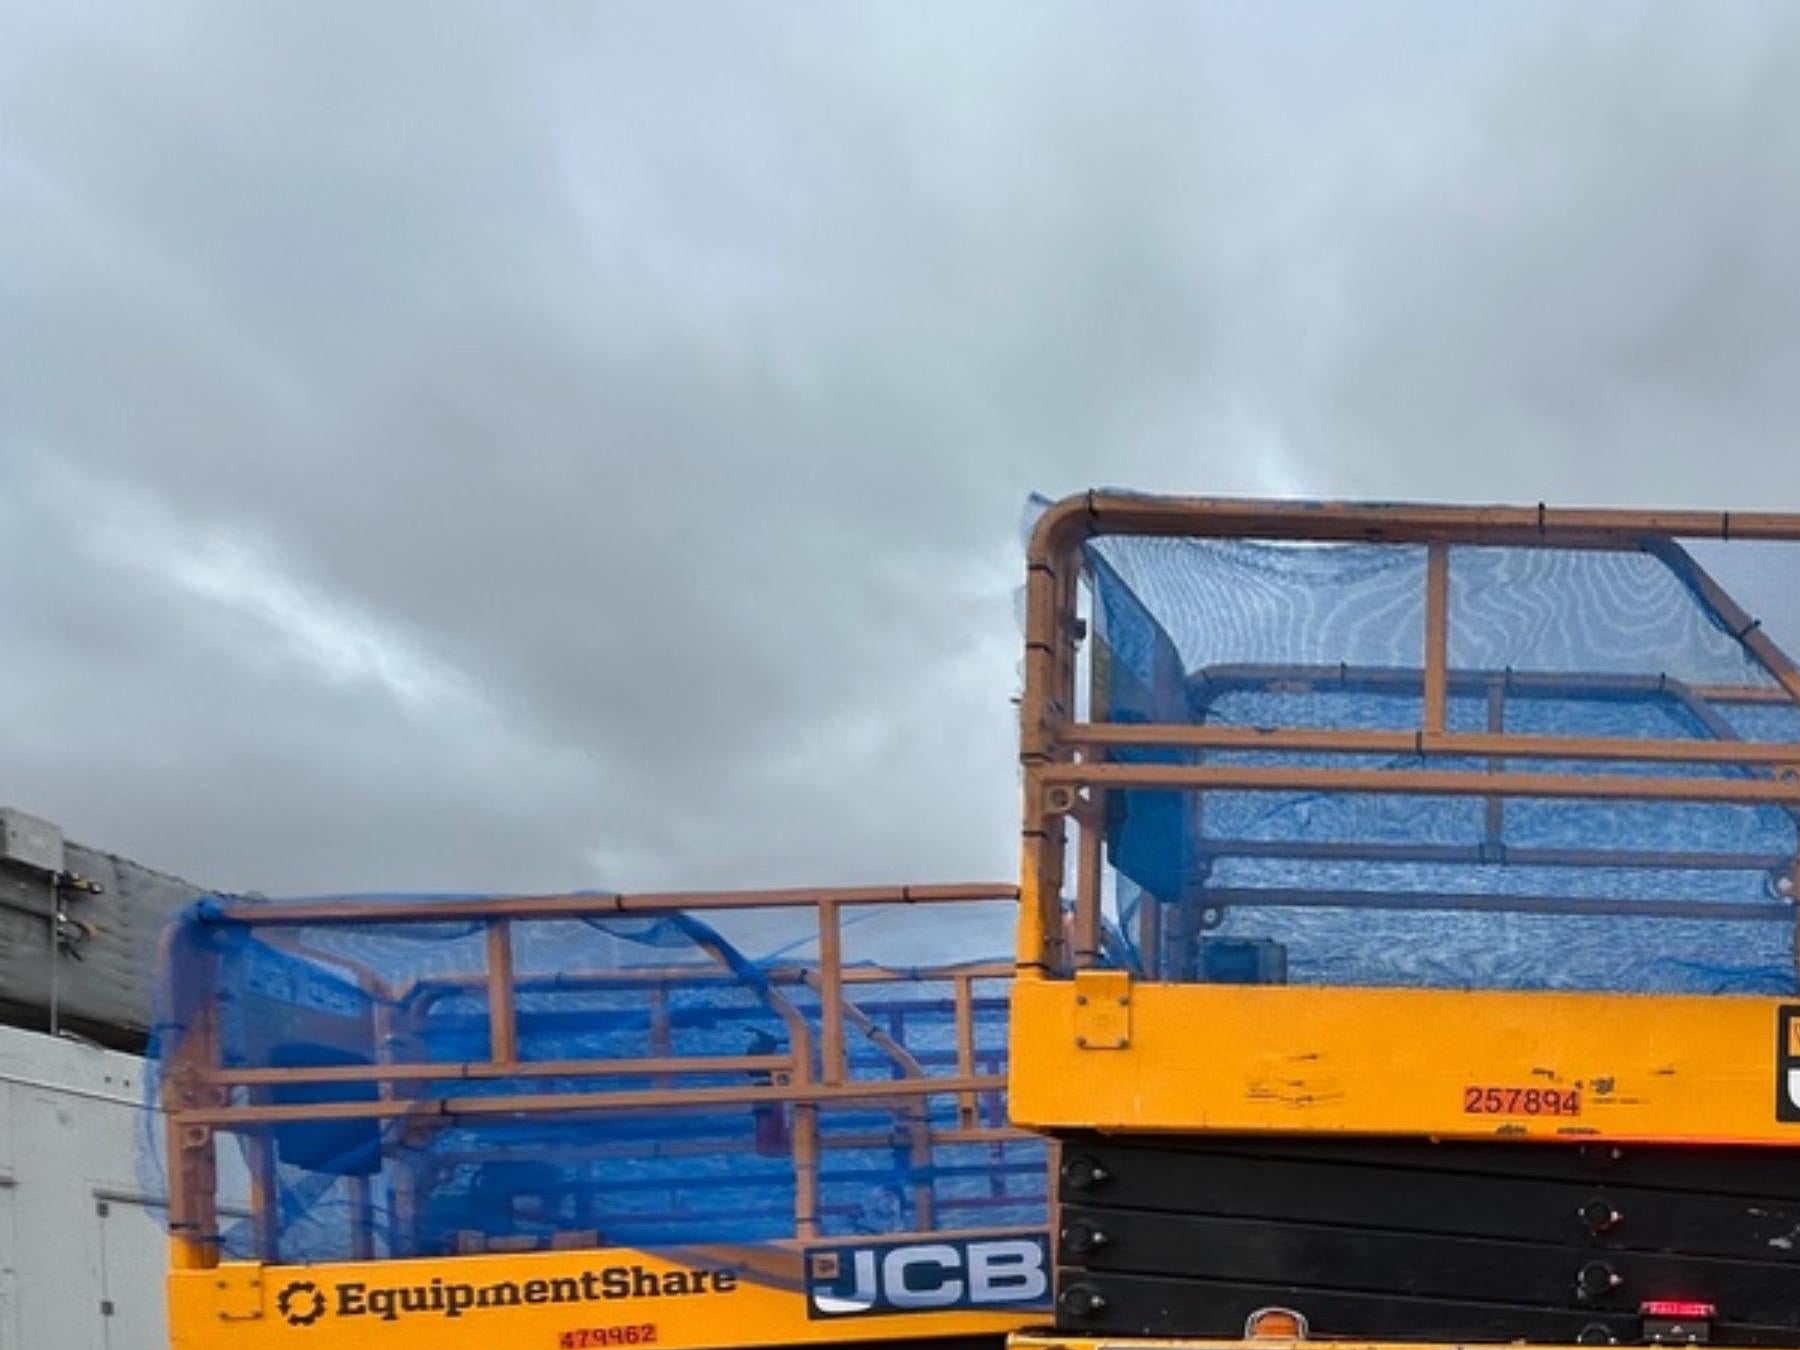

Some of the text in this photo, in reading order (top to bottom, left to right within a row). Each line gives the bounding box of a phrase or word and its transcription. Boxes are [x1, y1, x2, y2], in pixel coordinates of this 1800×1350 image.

[1464, 1086, 1579, 1116] 257894
[336, 1266, 737, 1320] EquipmentShare
[812, 1239, 1048, 1313] JCB
